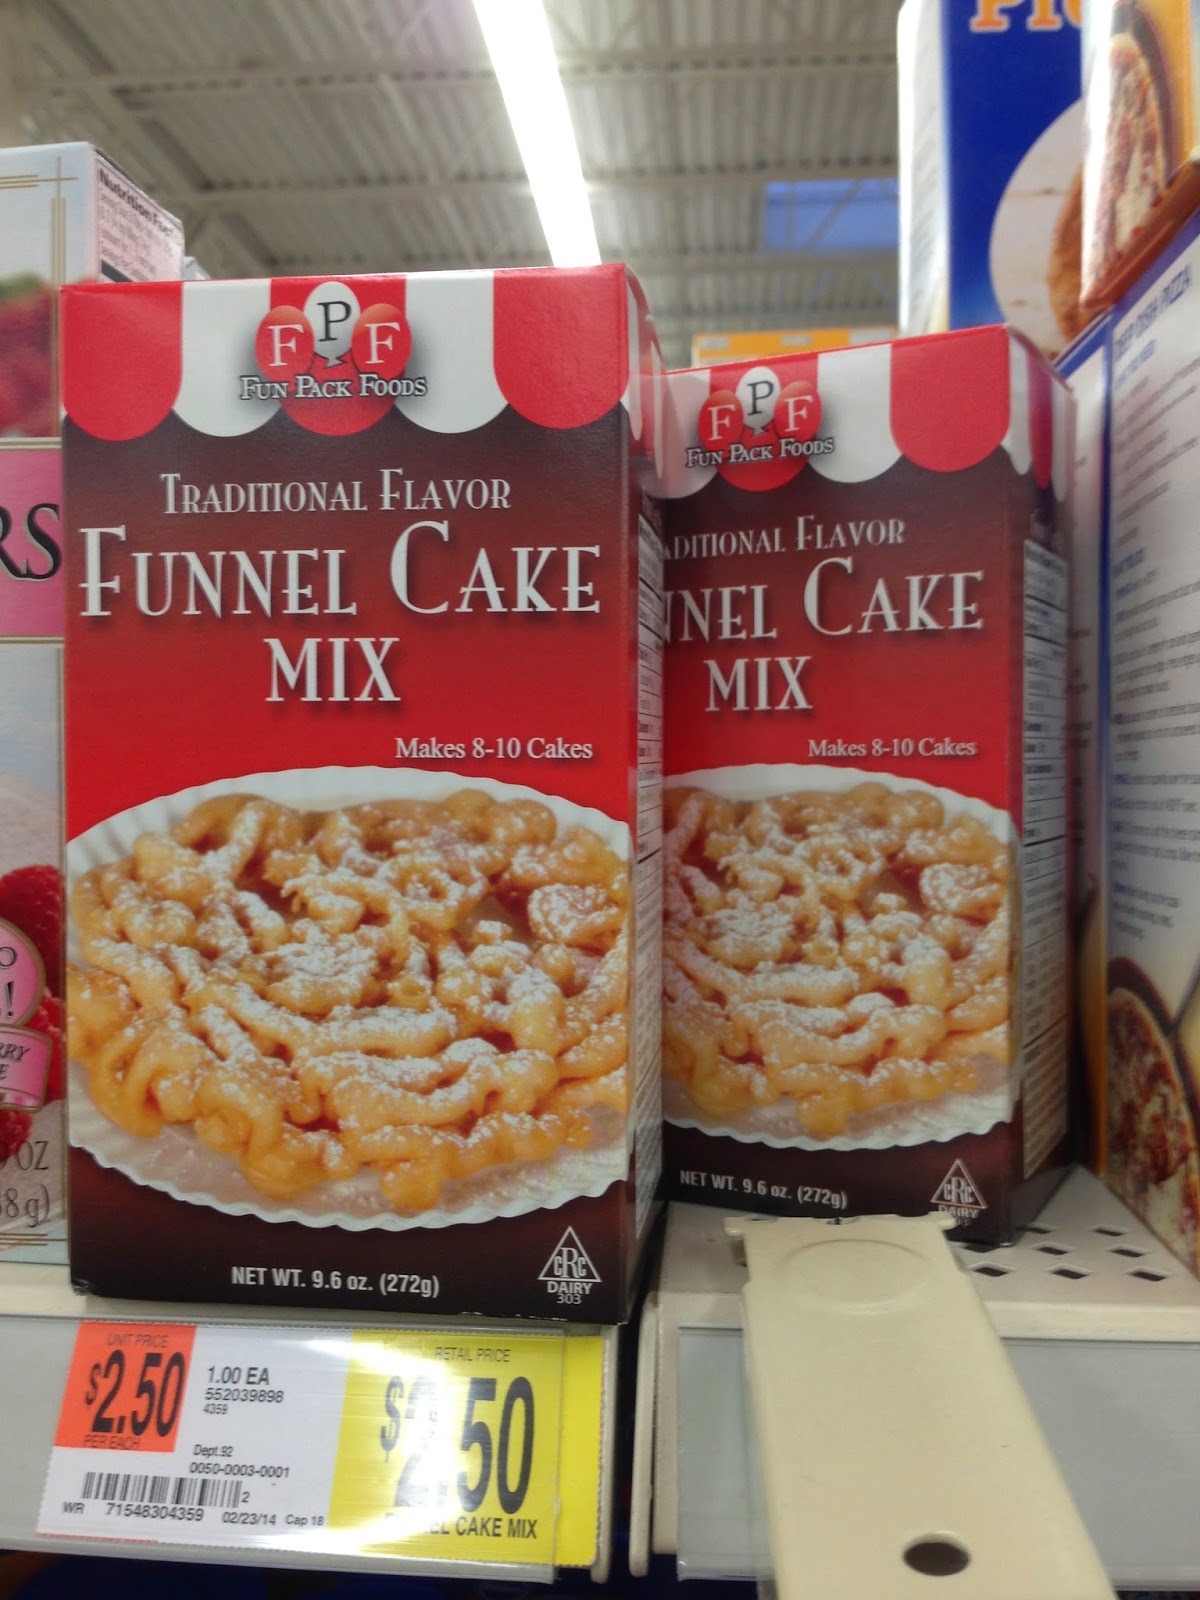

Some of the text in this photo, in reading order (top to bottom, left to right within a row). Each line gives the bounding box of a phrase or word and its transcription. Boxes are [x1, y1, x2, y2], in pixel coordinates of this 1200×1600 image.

[240, 373, 427, 400] FUN PACK FOODS
[685, 437, 835, 468] FUN PACK FOODS
[160, 468, 512, 514] TRADITIONAL FLAVOR
[796, 514, 906, 551] FLAVOR
[79, 520, 601, 619] FUNNEL CAKE
[803, 556, 984, 637] CAKE
[264, 637, 401, 702] MIX
[704, 656, 813, 713] MIX
[395, 737, 593, 760] Makes 8-10 Cakes
[808, 737, 977, 758] Makes 8-10 Cakes
[680, 1169, 849, 1211] NET WT. 9.6 oz. (272g)
[231, 1266, 440, 1298] NET WT. 9.6 oz. (272g)
[546, 1280, 594, 1296] DAIRY
[556, 1293, 583, 1305] 303
[107, 1333, 169, 1348] UNIT PRICE
[434, 1346, 511, 1363] RETAIL PRICE
[208, 1366, 270, 1386] 1.00 EA
[204, 1387, 285, 1404] 552039898
[202, 1403, 229, 1416] 4359
[84, 1433, 141, 1450] PER EACH
[188, 1461, 290, 1478] 0050-0003-0001
[241, 1491, 250, 1504] 2
[62, 1501, 325, 1527] WR 71548304359 02/23/14 Cap 18
[455, 1516, 503, 1538] CAKE
[507, 1518, 539, 1540] MIX
